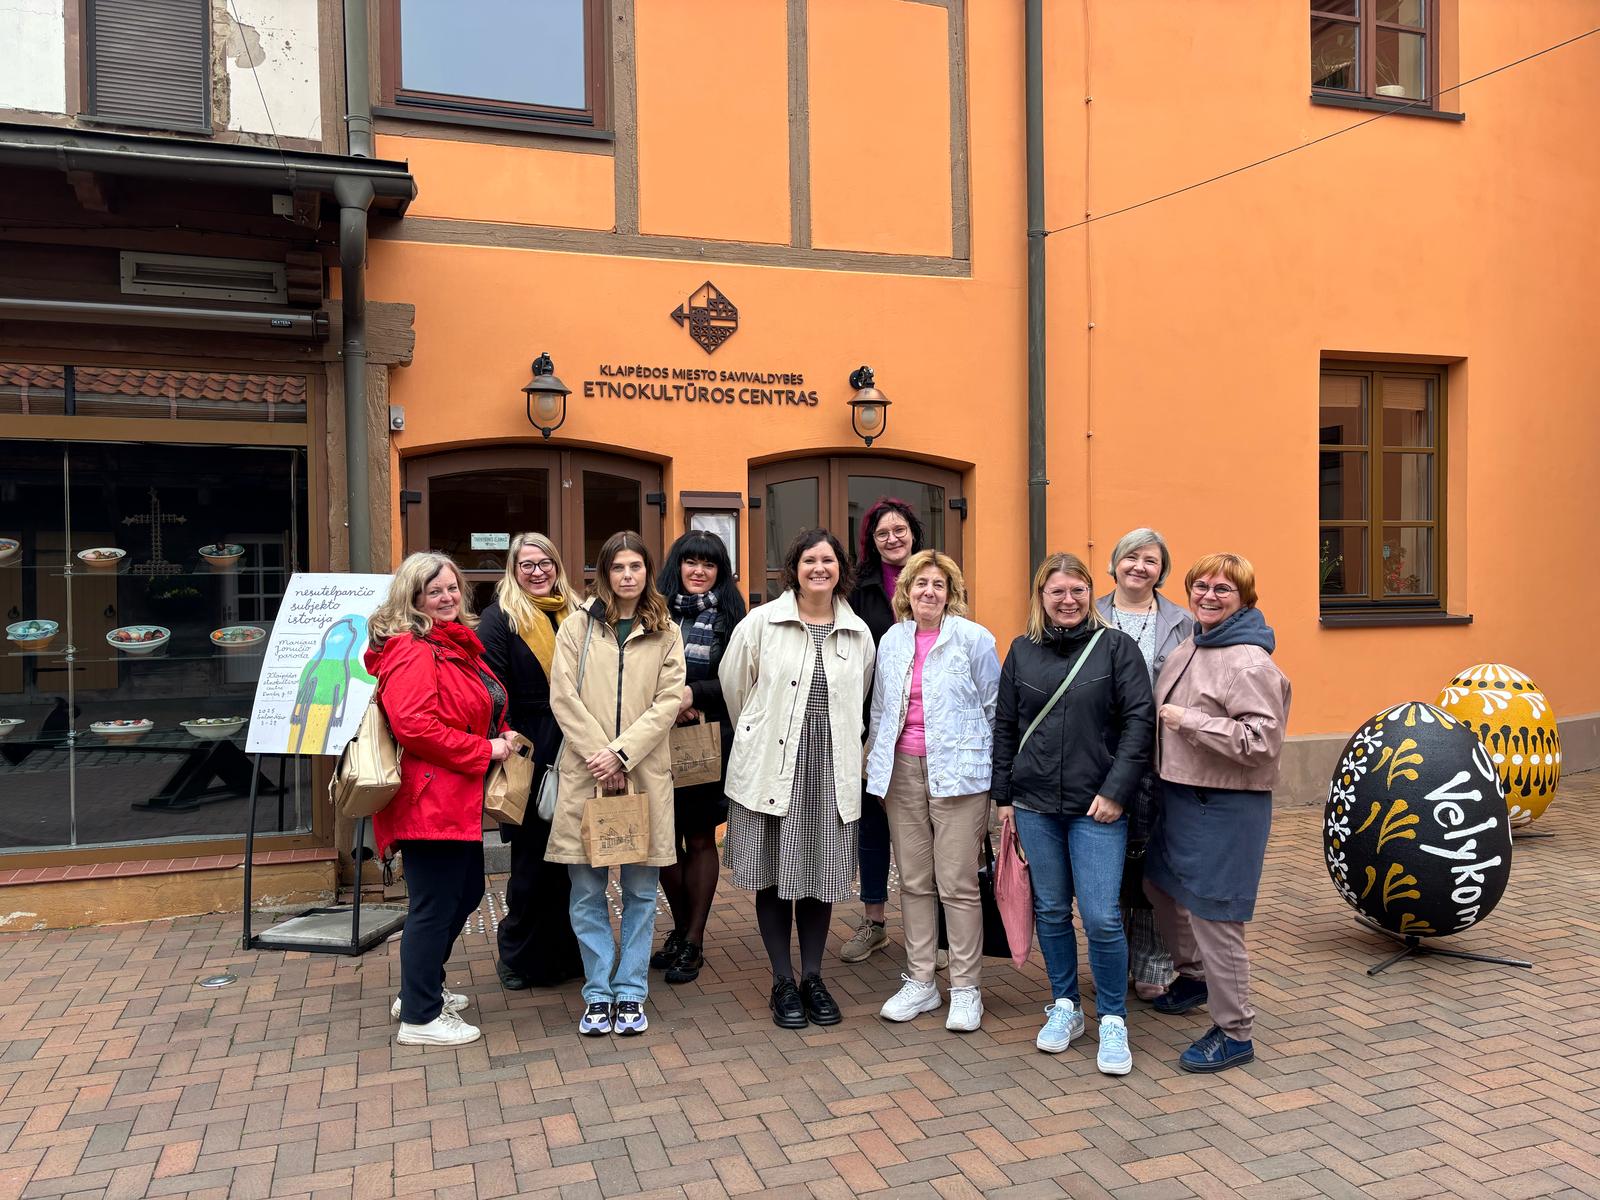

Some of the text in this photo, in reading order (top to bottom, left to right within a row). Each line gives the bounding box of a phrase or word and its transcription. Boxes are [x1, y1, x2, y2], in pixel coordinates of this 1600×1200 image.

[600, 364, 804, 386] KLAIPĖDOS MIESTO SAVIVALDYBĖS
[583, 381, 819, 407] ETNOKULTŪROS CENTRAS
[295, 585, 375, 602] nesutelpančio
[290, 598, 341, 615] subjekto
[287, 612, 334, 630] istorija
